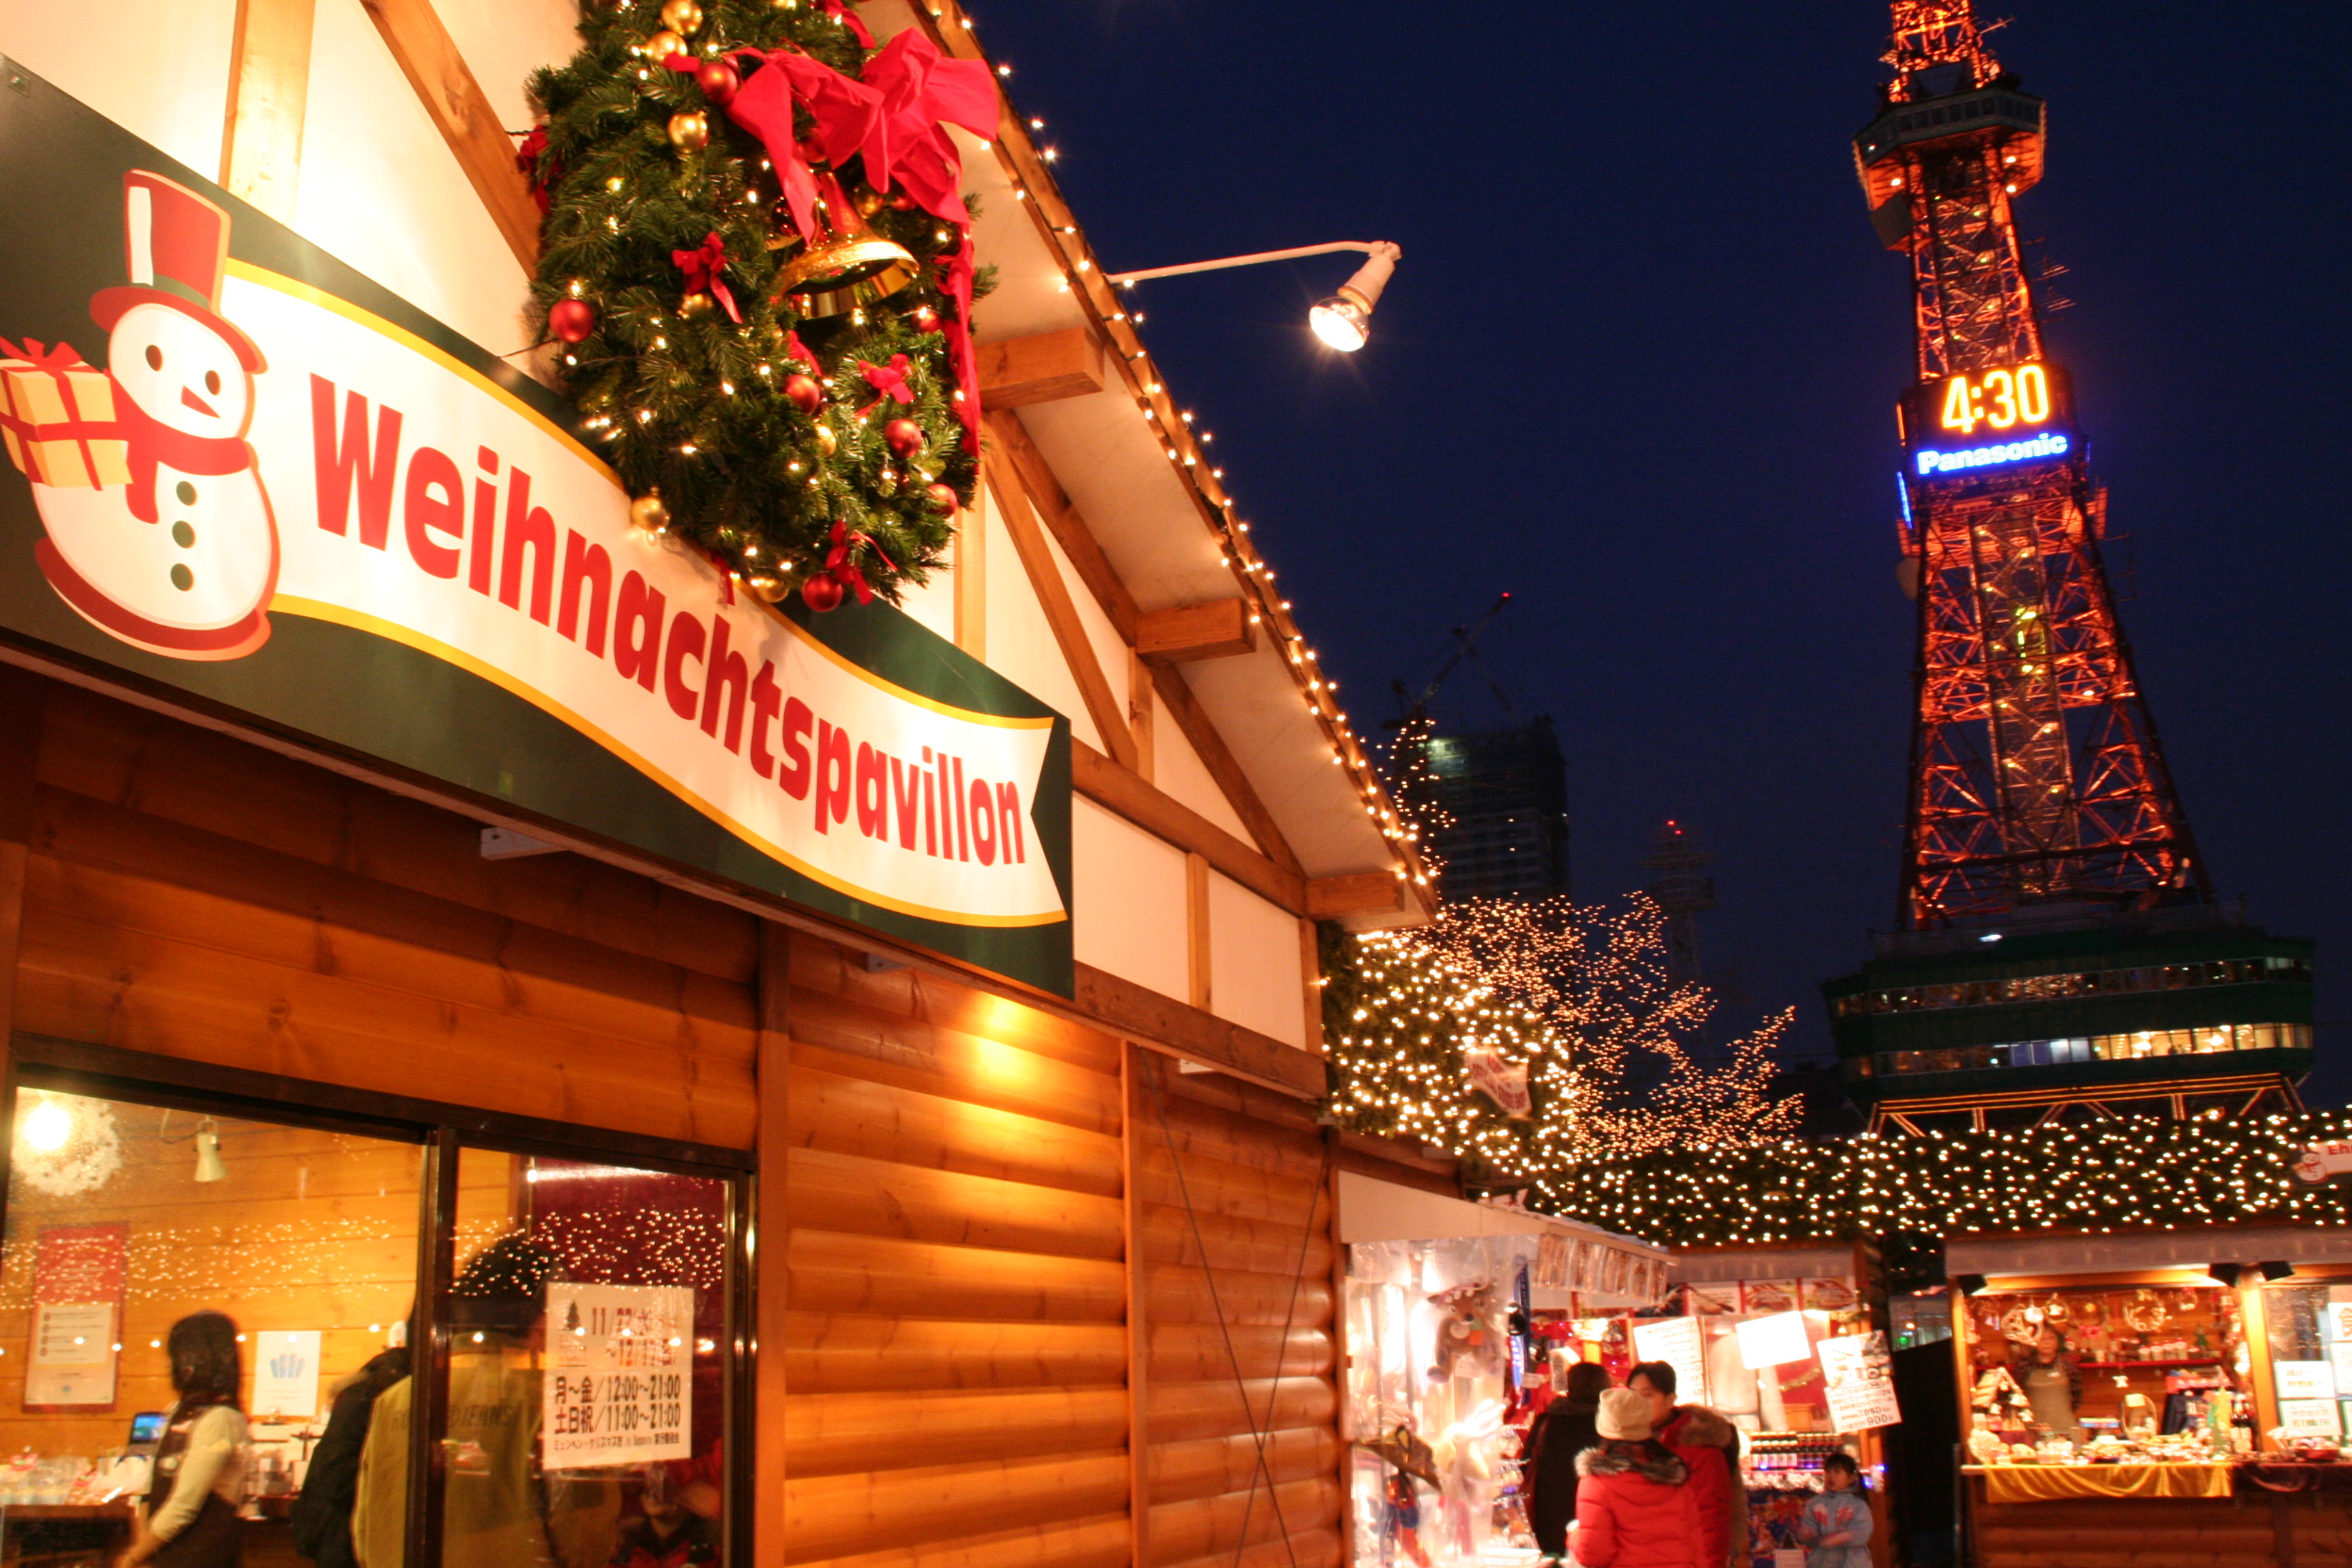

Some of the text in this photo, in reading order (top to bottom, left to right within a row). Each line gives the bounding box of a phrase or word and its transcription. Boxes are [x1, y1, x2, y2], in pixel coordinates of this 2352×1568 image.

[1942, 366, 2050, 432] 4:30
[1917, 434, 2067, 475] Panasonic
[309, 372, 1027, 867] Weihnachtspavillon
